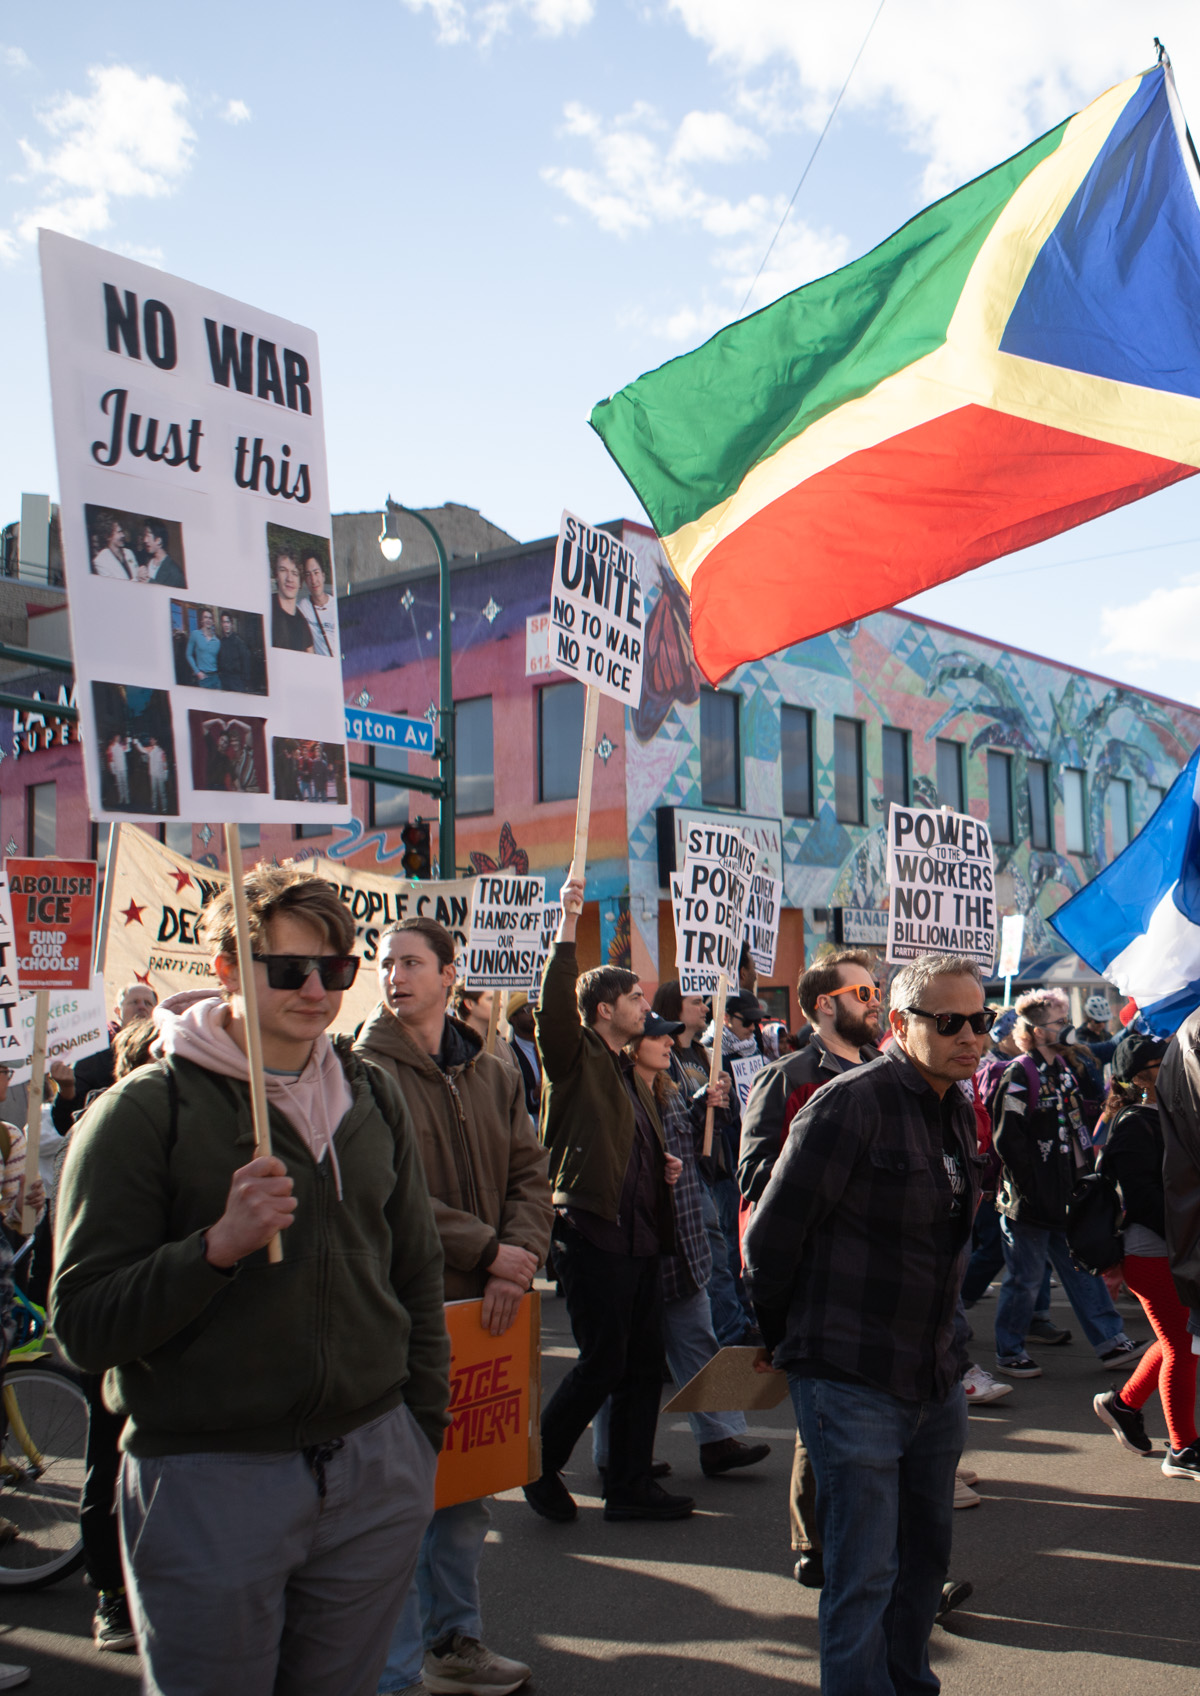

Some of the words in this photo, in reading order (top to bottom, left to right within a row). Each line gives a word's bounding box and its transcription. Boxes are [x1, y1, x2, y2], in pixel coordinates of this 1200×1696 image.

[103, 282, 178, 371] NO
[203, 317, 312, 416] WAR
[90, 388, 204, 472] Just
[235, 436, 312, 503] this
[561, 539, 642, 630] UNITE
[531, 616, 550, 635] SP
[554, 595, 576, 628] NO
[581, 610, 601, 639] TO
[606, 622, 641, 664] WAR
[558, 631, 580, 664] NO
[586, 646, 604, 676] TO
[607, 659, 632, 693] ICE
[404, 724, 428, 746] Av
[895, 811, 991, 860] POWER
[935, 847, 946, 859] TO
[949, 848, 960, 861] THE
[9, 875, 93, 896] ABOLISH
[895, 854, 993, 893] WORKERS
[479, 878, 543, 906] TRUMP:
[27, 896, 72, 924] ICE
[416, 895, 468, 927] CAN
[474, 909, 519, 930] HANDS
[520, 912, 541, 931] OFF
[685, 897, 709, 922] TO
[895, 887, 944, 923] NOT
[953, 894, 994, 930] THE
[29, 930, 67, 944] FUND
[31, 944, 63, 957] OUR
[497, 935, 514, 949] OUR
[894, 921, 994, 953] BILLIONAIRES!
[150, 956, 189, 972] PARTY
[189, 962, 211, 976] FOR
[470, 949, 536, 975] UNIONS!
[734, 1061, 748, 1077] WE
[749, 1058, 762, 1074] ARE
